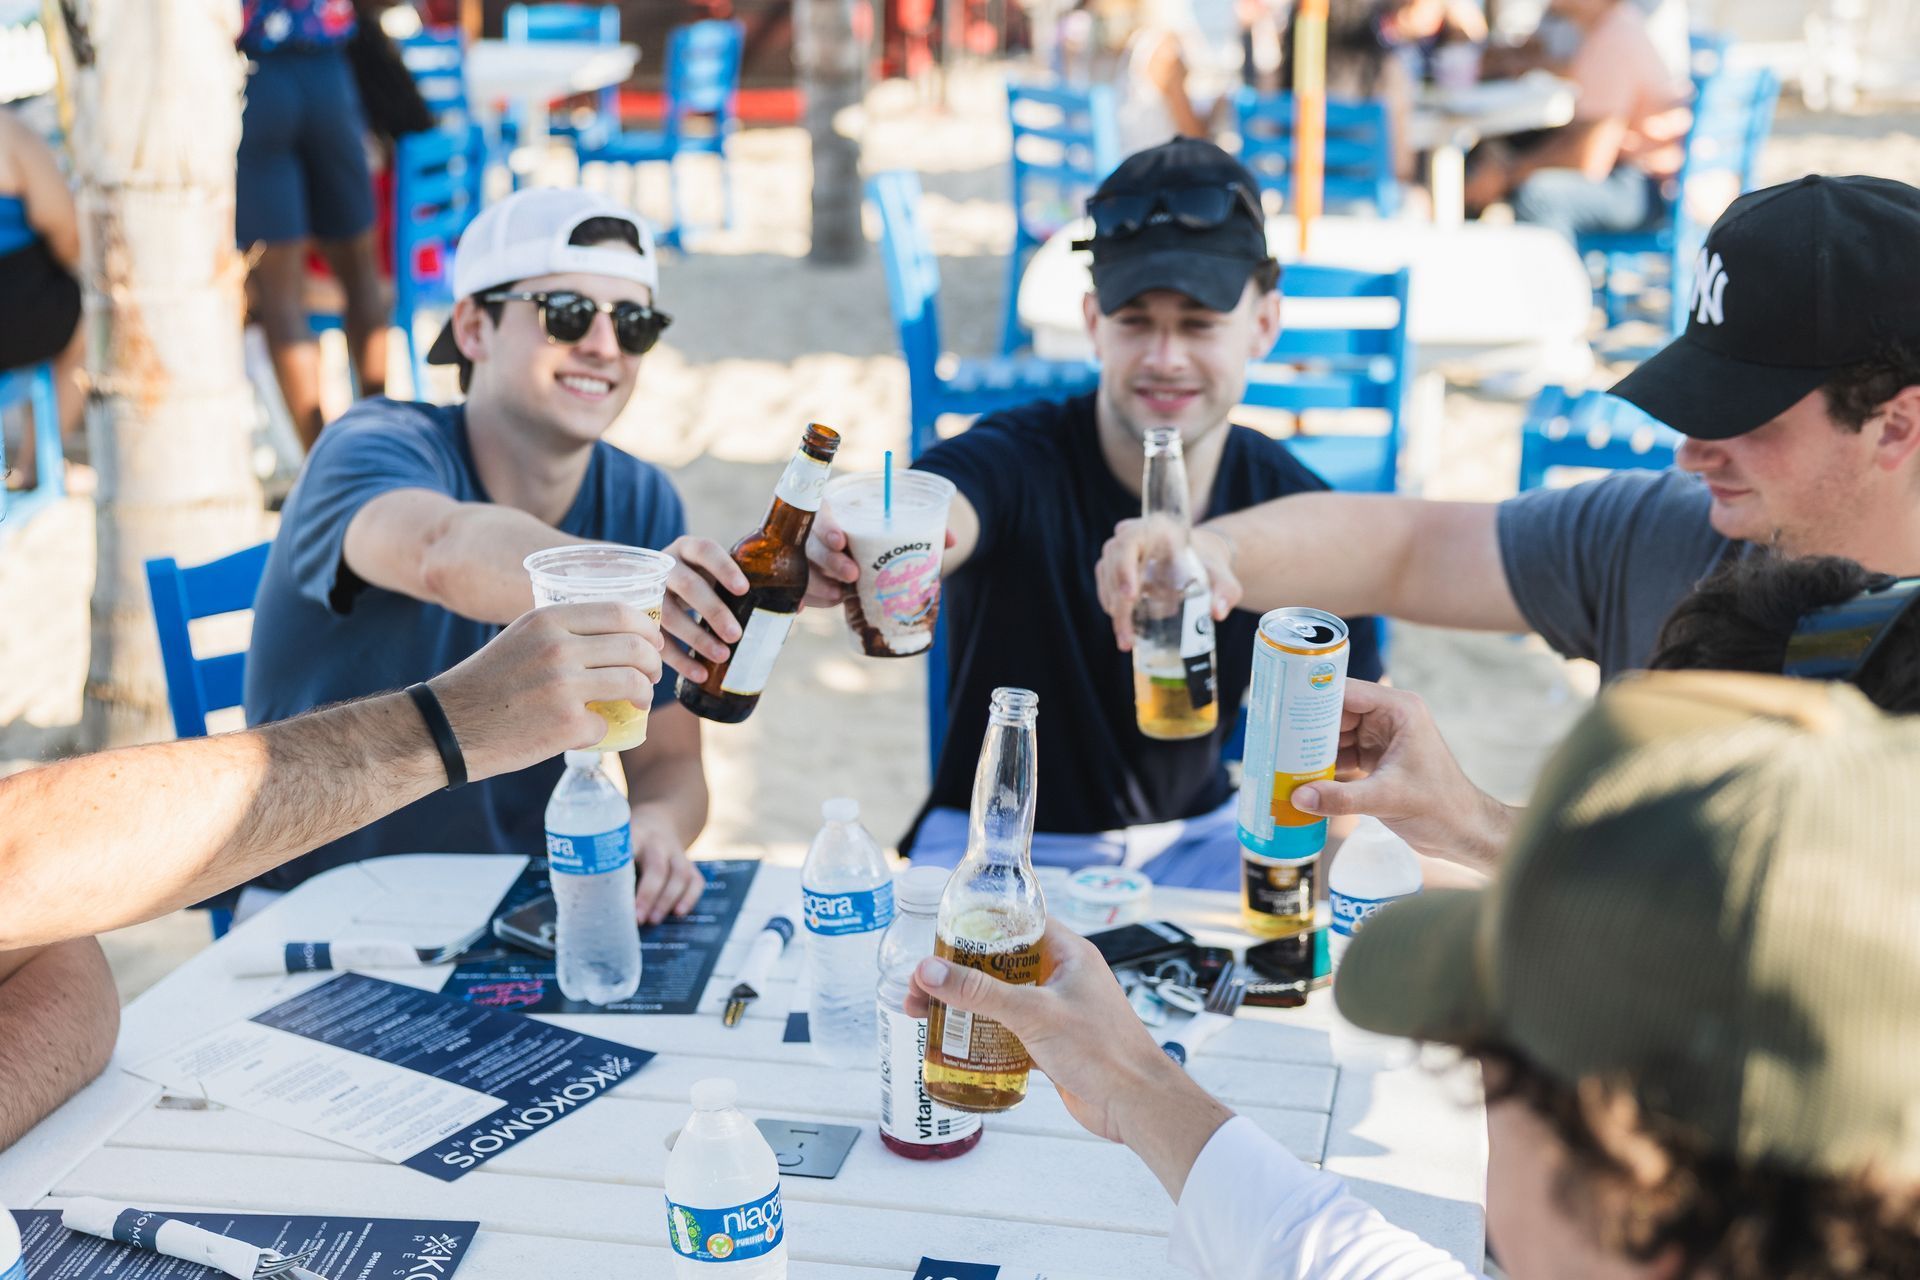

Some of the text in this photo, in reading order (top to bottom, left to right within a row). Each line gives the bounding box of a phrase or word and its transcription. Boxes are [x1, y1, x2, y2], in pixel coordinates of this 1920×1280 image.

[991, 952, 1040, 973] Corona
[1005, 969, 1031, 980] Extra
[442, 1068, 618, 1169] KOKOMO'S
